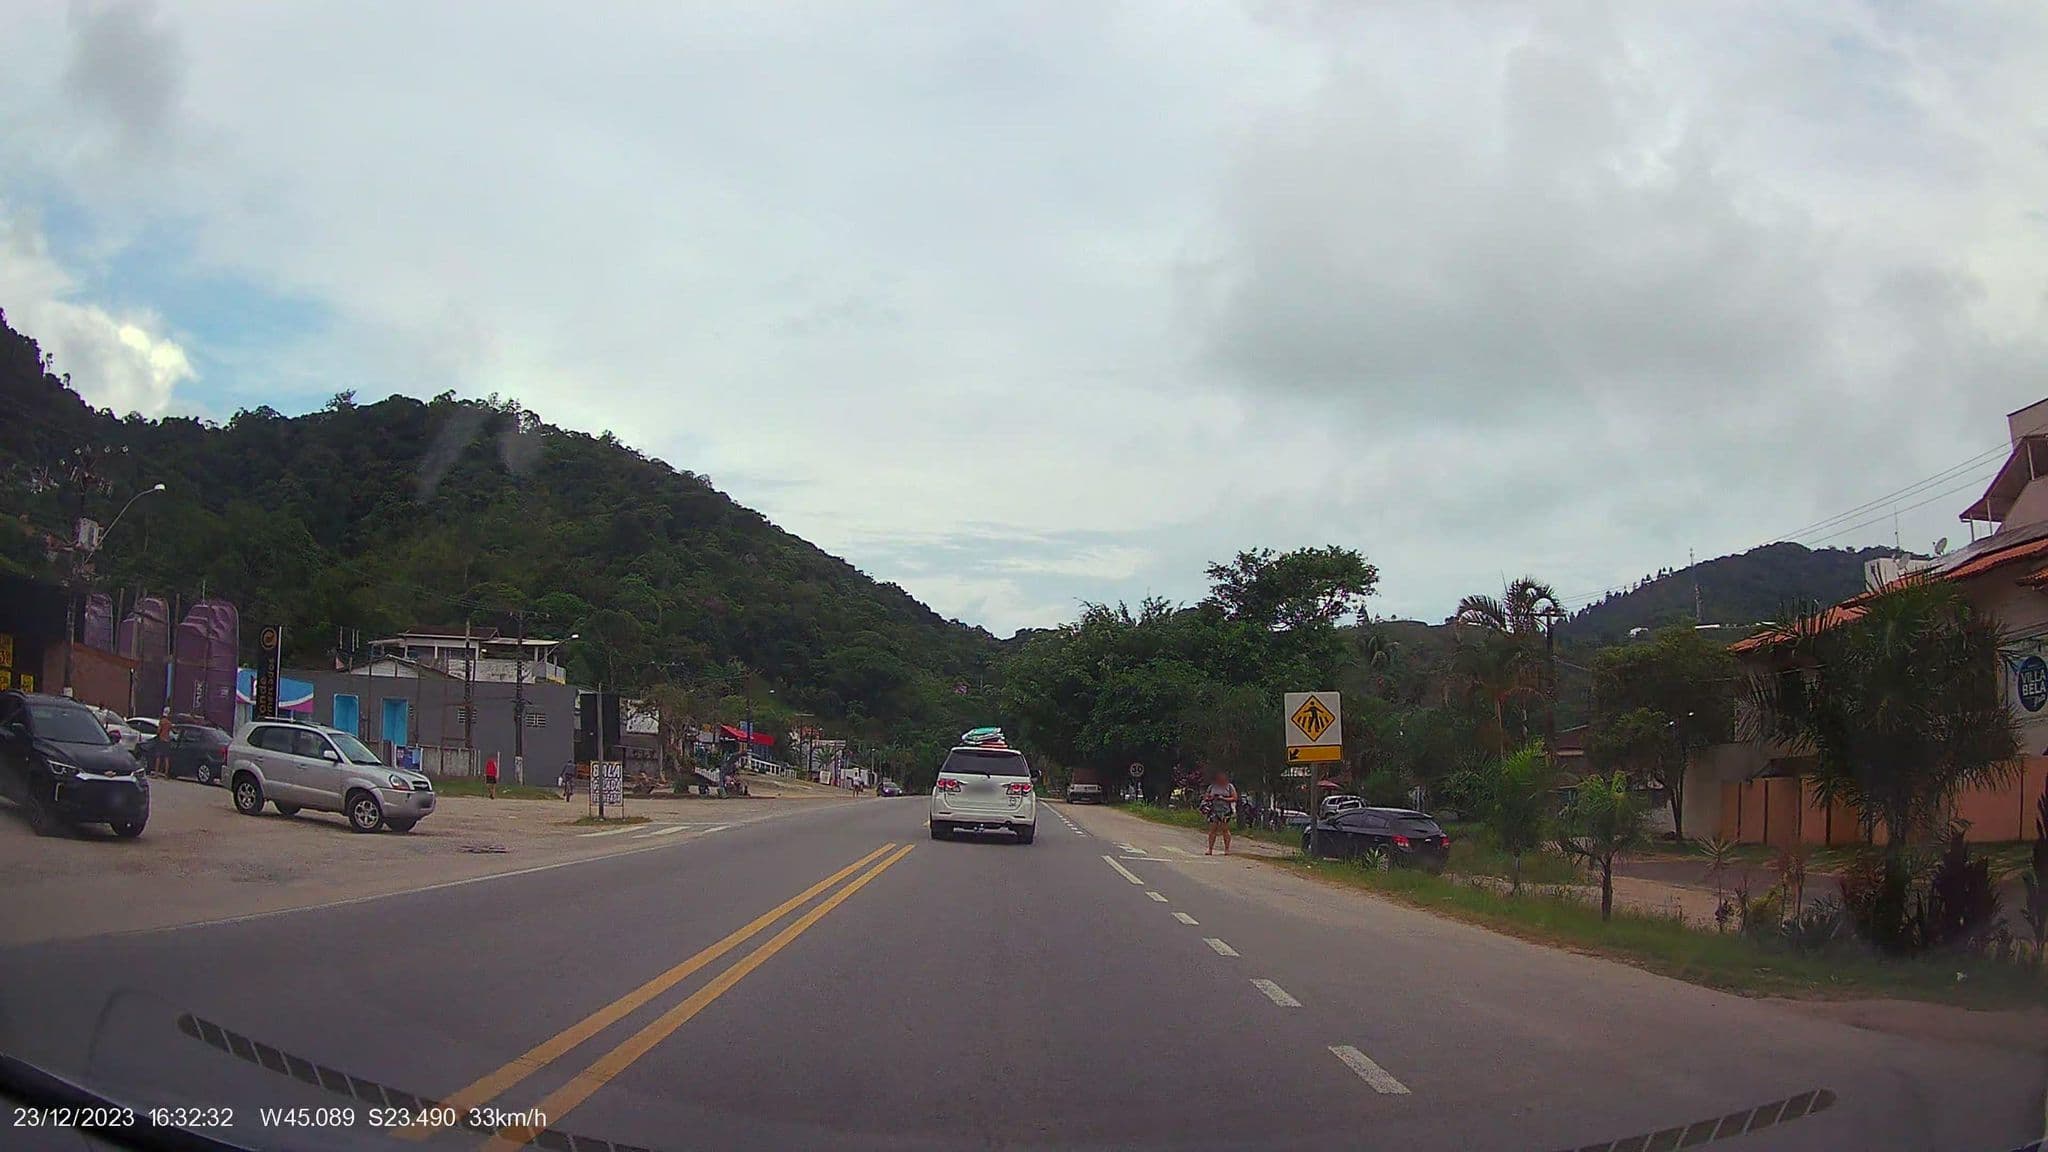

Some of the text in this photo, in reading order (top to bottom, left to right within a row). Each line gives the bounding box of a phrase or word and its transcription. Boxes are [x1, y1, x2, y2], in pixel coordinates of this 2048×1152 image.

[2021, 669, 2046, 684] VILLA
[2022, 681, 2047, 696] BELA
[593, 780, 621, 791] GLADA
